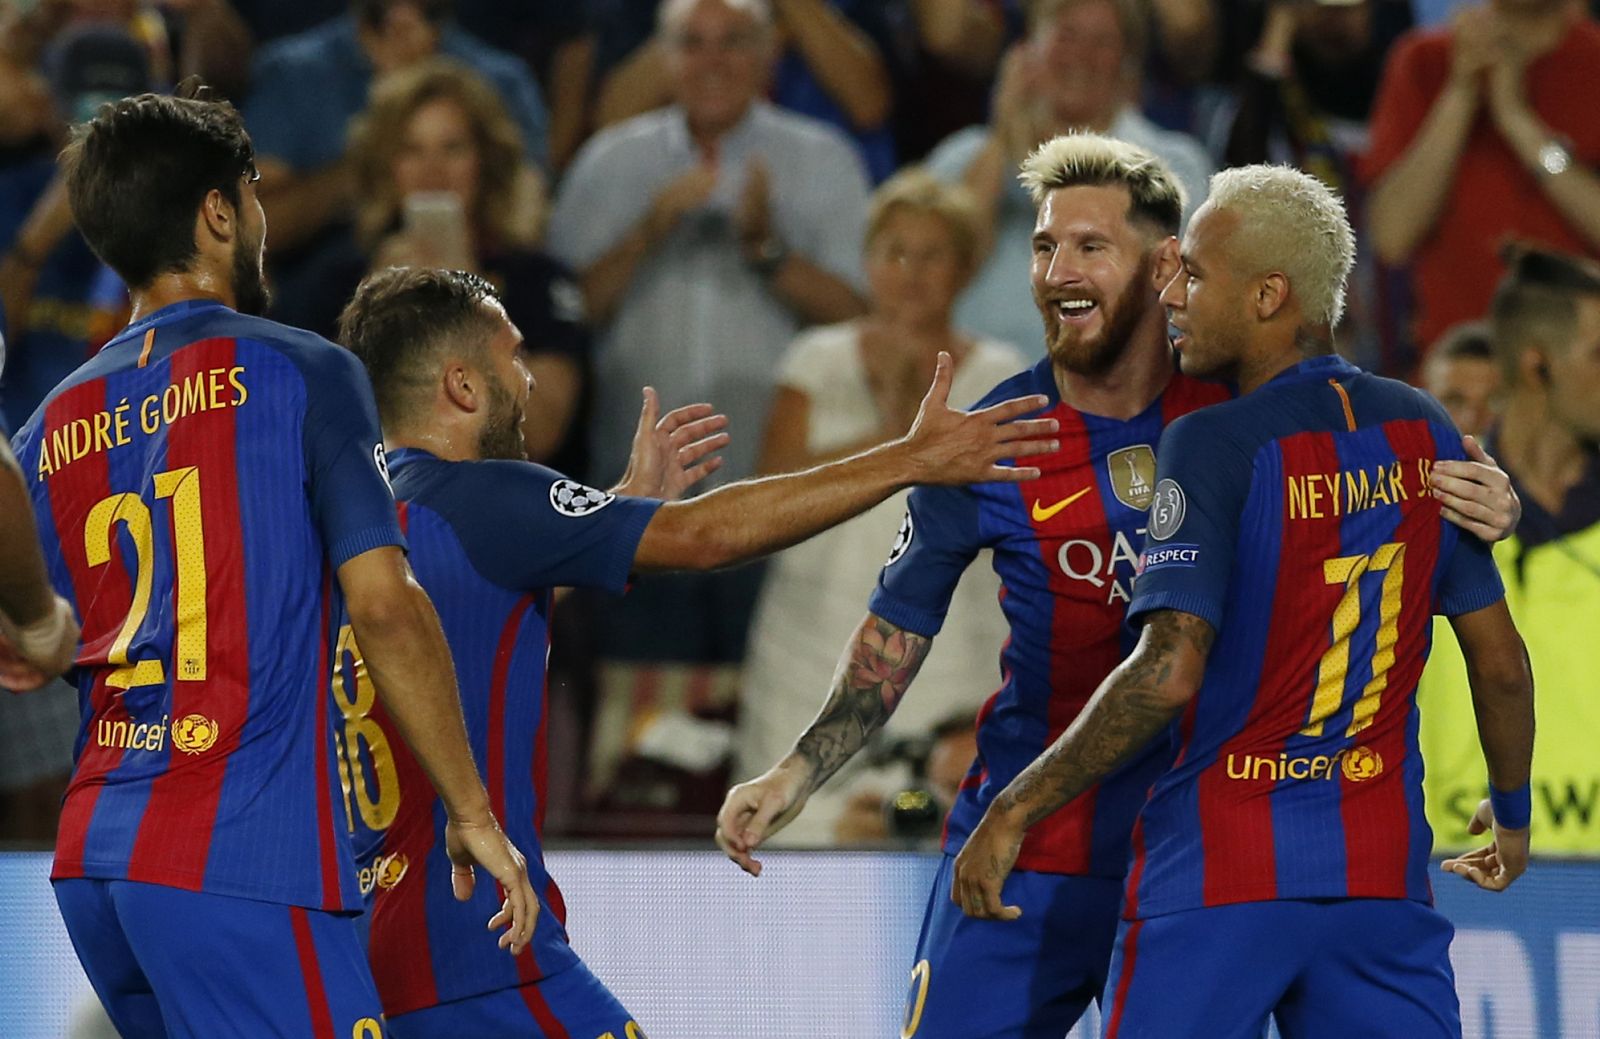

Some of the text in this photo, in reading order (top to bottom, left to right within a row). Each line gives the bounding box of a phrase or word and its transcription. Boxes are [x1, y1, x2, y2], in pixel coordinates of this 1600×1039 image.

[37, 365, 249, 482] ANDRÉ GOMES
[1128, 485, 1151, 498] FIFA
[1287, 460, 1409, 520] NEYMAR
[1159, 507, 1169, 525] 5
[83, 465, 207, 690] 21
[1057, 528, 1147, 588] QA
[1146, 549, 1200, 567] RESPECT
[1298, 541, 1407, 738] 11
[97, 713, 169, 752] unicef
[1226, 748, 1347, 781] unicef
